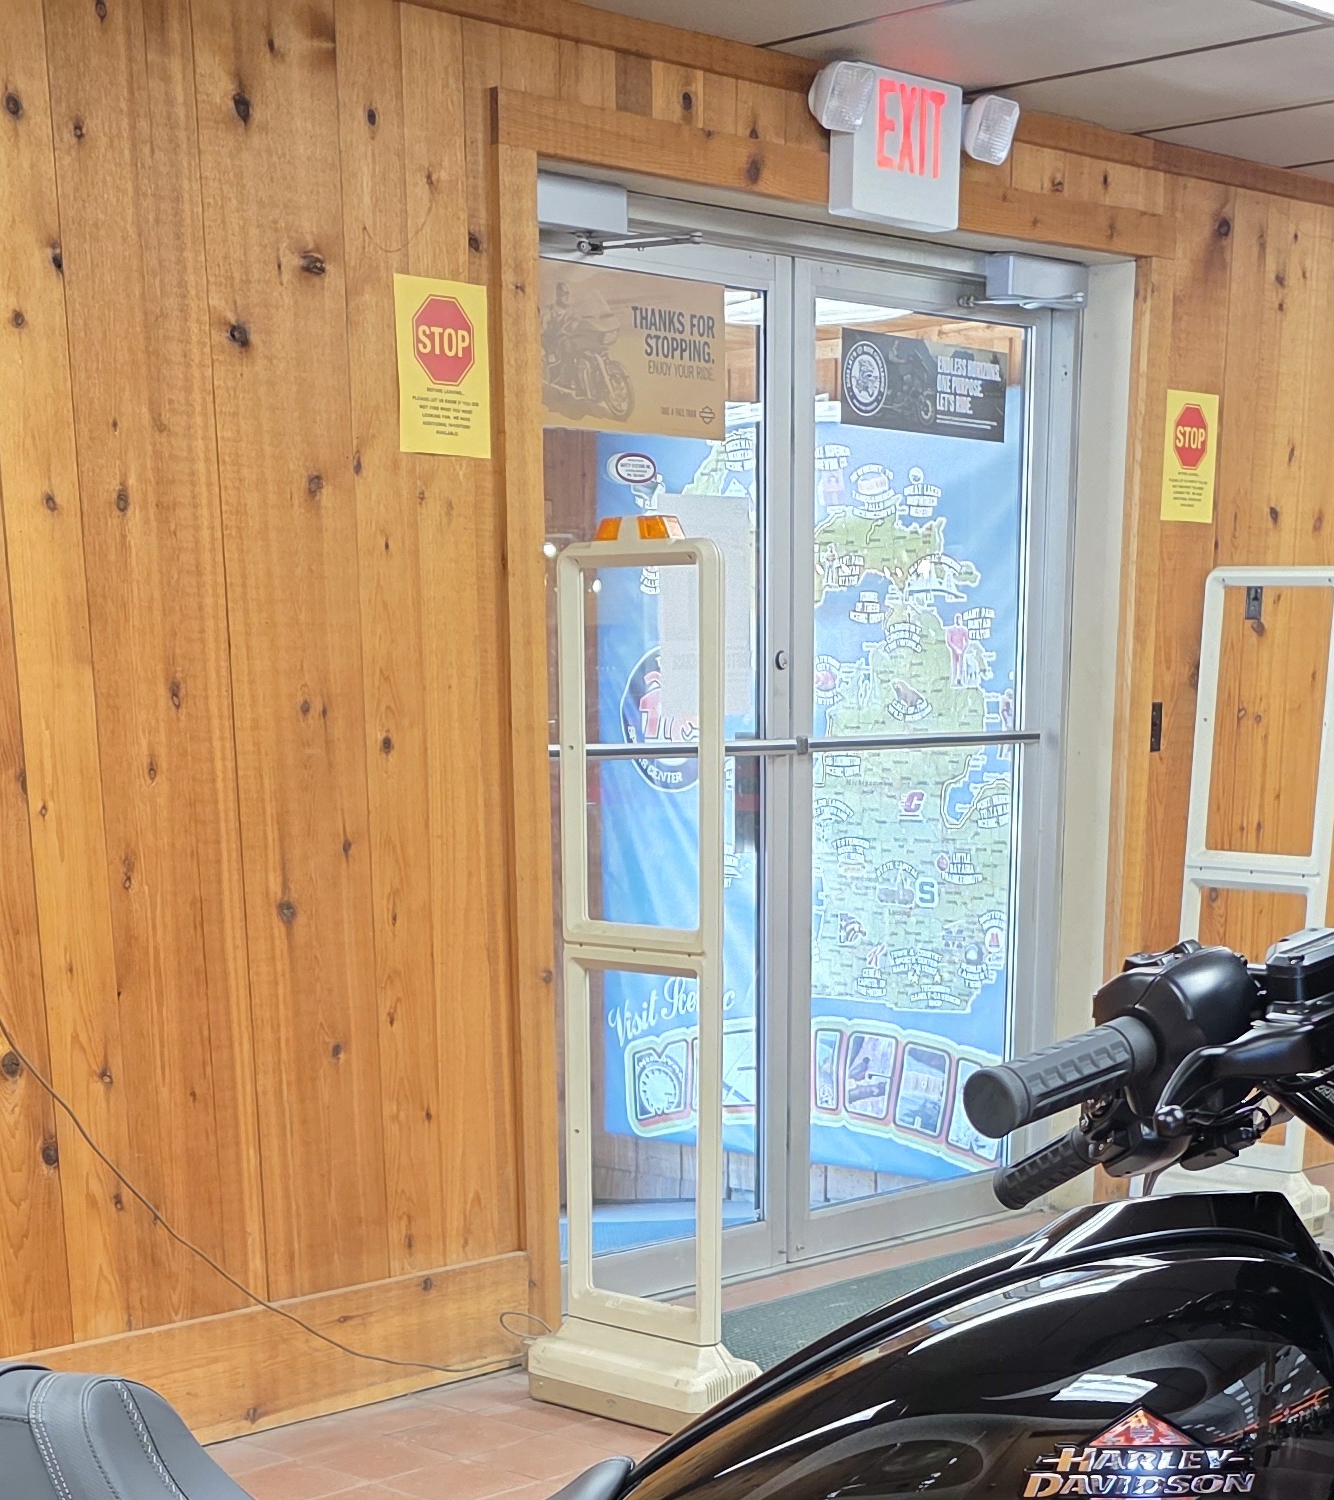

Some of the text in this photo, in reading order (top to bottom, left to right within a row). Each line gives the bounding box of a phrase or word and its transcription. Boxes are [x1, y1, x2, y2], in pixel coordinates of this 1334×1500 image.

[876, 78, 947, 180] EXIT
[631, 305, 715, 339] THANKS FOR
[418, 324, 470, 358] STOP
[644, 333, 715, 364] STOPPING.
[648, 360, 672, 377] ENJOY
[674, 363, 695, 380] YOUR
[937, 355, 967, 376] ENDLESS
[936, 373, 984, 398] ONE PURPOSE.
[936, 393, 955, 412] LET'S
[1175, 425, 1206, 450] STOP
[646, 764, 684, 784] CENTER
[919, 880, 936, 904] S
[608, 976, 736, 1047] Visit Scec
[1023, 1473, 1255, 1499] DAVIDSON
